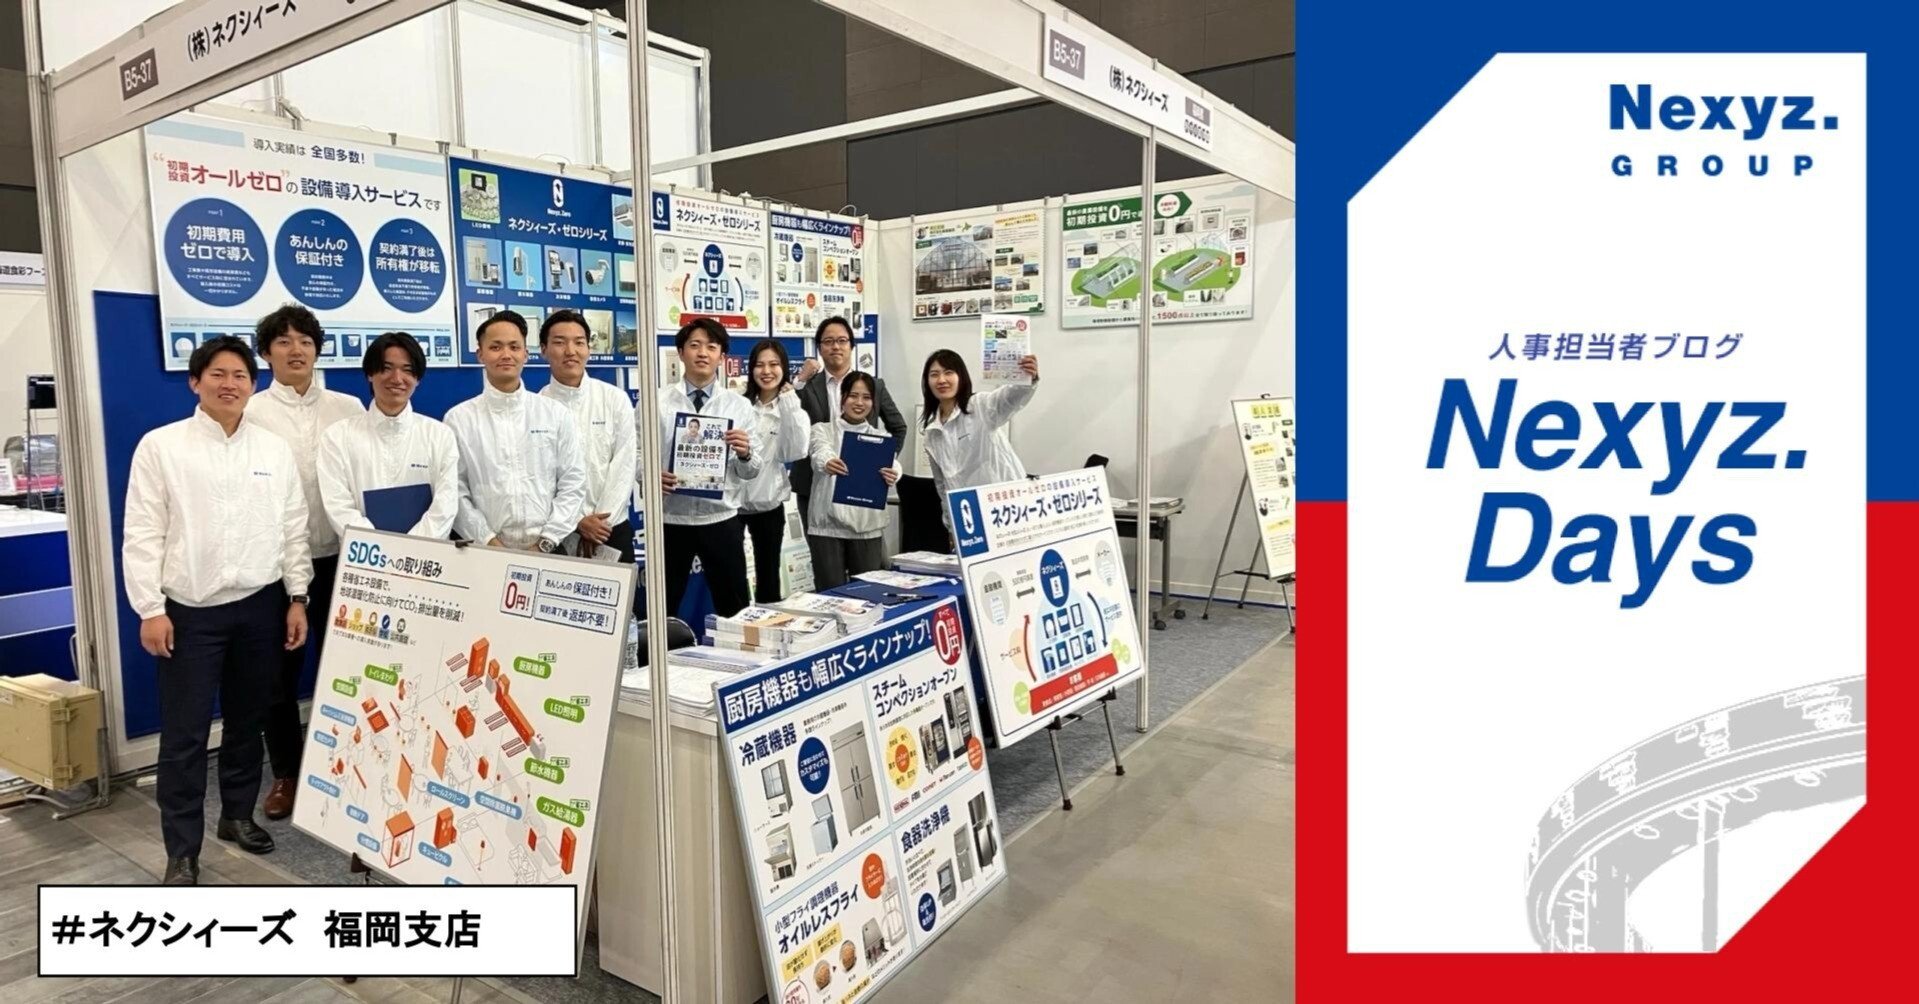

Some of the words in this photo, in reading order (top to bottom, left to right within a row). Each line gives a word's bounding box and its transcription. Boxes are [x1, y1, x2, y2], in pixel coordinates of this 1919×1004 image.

[1053, 39, 1082, 70] B5-37
[124, 58, 152, 92] B5-37
[1109, 64, 1169, 113] (株)ネクシィーズ
[252, 137, 306, 156] 導入実績は
[310, 145, 366, 165] 全国多数!
[186, 224, 245, 244] 初期費用
[508, 217, 607, 242] ネクシィーズ・ゼロシリーズ
[676, 208, 760, 232] ネクシィーズ・ゼロシリーズ
[180, 242, 255, 262] ゼロで導入
[290, 235, 348, 251] あんしんの
[379, 242, 435, 258] 契約満了後は
[295, 251, 344, 267] 保証付き
[375, 257, 440, 274] 所有権が移転
[991, 486, 1102, 528] ネクシィーズ・ゼロシリーズ
[505, 581, 531, 611] 0円!
[725, 618, 931, 722] 厨房機器も幅広くラインナップ!
[872, 674, 907, 700] スチーム
[875, 668, 957, 718] コンベクションオーブン
[550, 702, 579, 720] LED照明
[739, 722, 797, 767] 冷蔵機器
[901, 804, 951, 853] 食器洗浄機
[779, 884, 858, 954] オイルレスフライ
